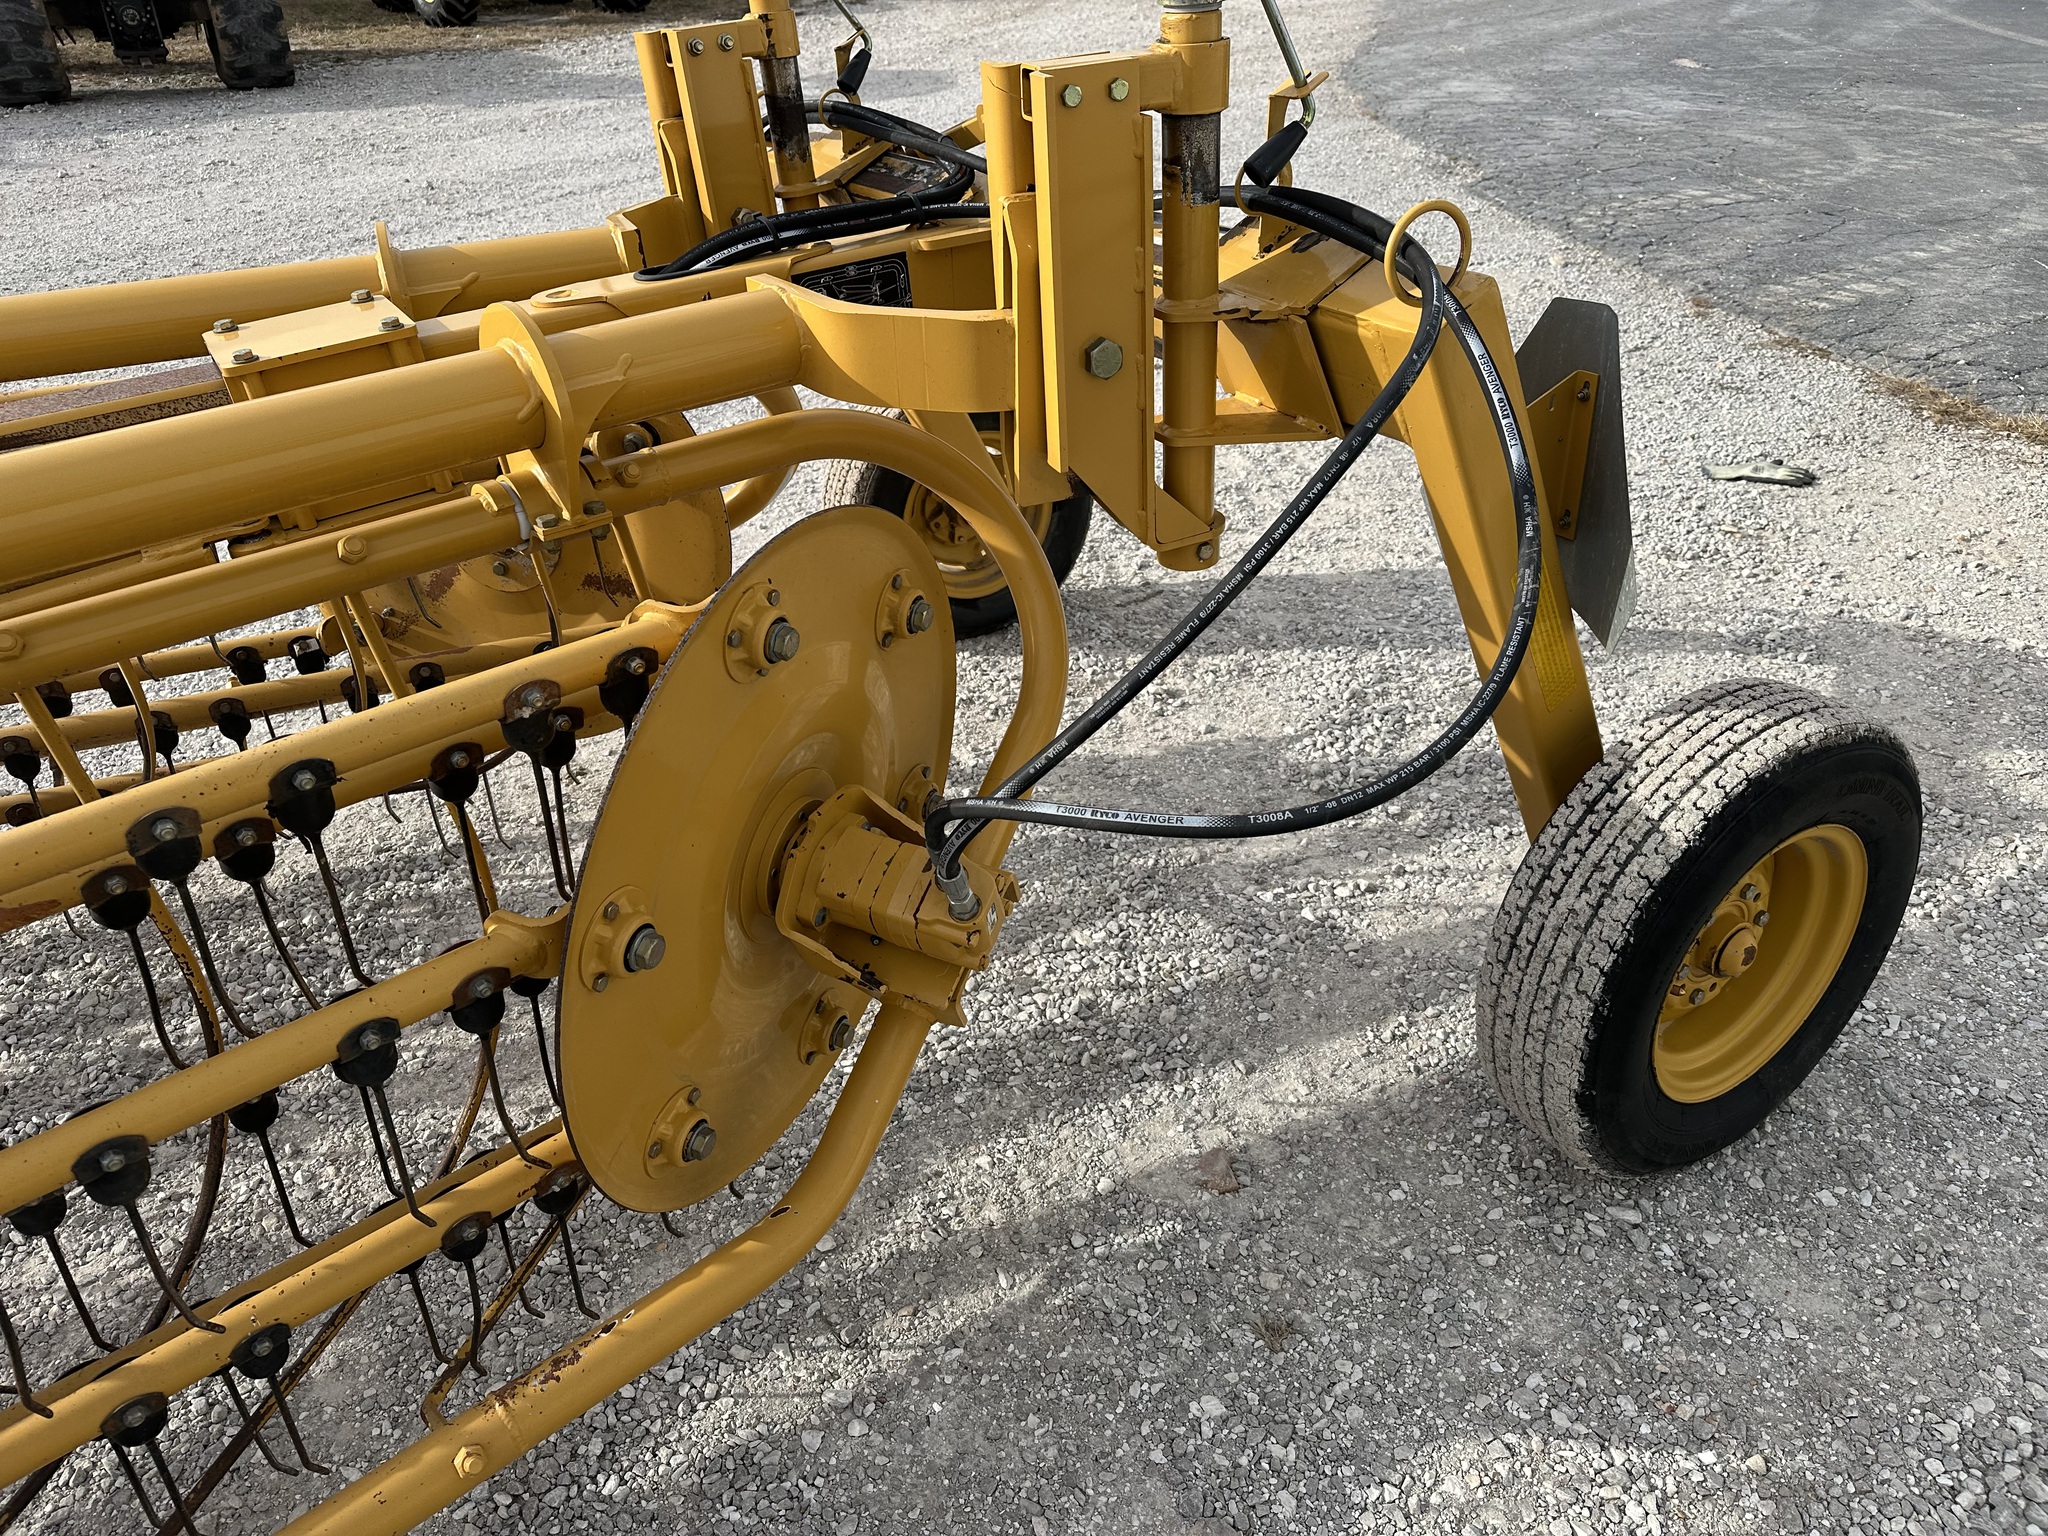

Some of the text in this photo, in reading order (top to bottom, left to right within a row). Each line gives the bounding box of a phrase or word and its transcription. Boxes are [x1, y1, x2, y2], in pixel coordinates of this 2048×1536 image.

[1477, 352, 1502, 395] AVENGER
[1504, 421, 1519, 450] T3000
[1307, 482, 1324, 500] MAX
[1298, 498, 1312, 513] WP
[1286, 510, 1300, 525] 215
[1525, 515, 1534, 537] MSHA
[1273, 522, 1289, 541] BAR
[1254, 542, 1271, 560] 3100
[1243, 559, 1257, 573] PSI
[1222, 572, 1244, 594] MSHA
[1174, 618, 1200, 644] FLAME
[1138, 641, 1176, 680] RESISTANT
[1248, 811, 1294, 824] T3008A
[1324, 800, 1338, 809] -08
[1341, 791, 1364, 804] DN12
[1366, 781, 1386, 795] MAX
[1385, 774, 1400, 786] WP
[1399, 765, 1414, 779] 215
[1413, 753, 1431, 769] BAR
[1434, 738, 1450, 753] 3100
[1449, 727, 1462, 740] PSI
[1460, 706, 1481, 728] MSHA
[1493, 655, 1512, 682] FLAME
[1506, 615, 1527, 657] RESISTANT
[1046, 739, 1069, 759] MSHA
[1056, 806, 1184, 825] T3000 RYCO AVENGER
[940, 839, 956, 869] AVENGER
